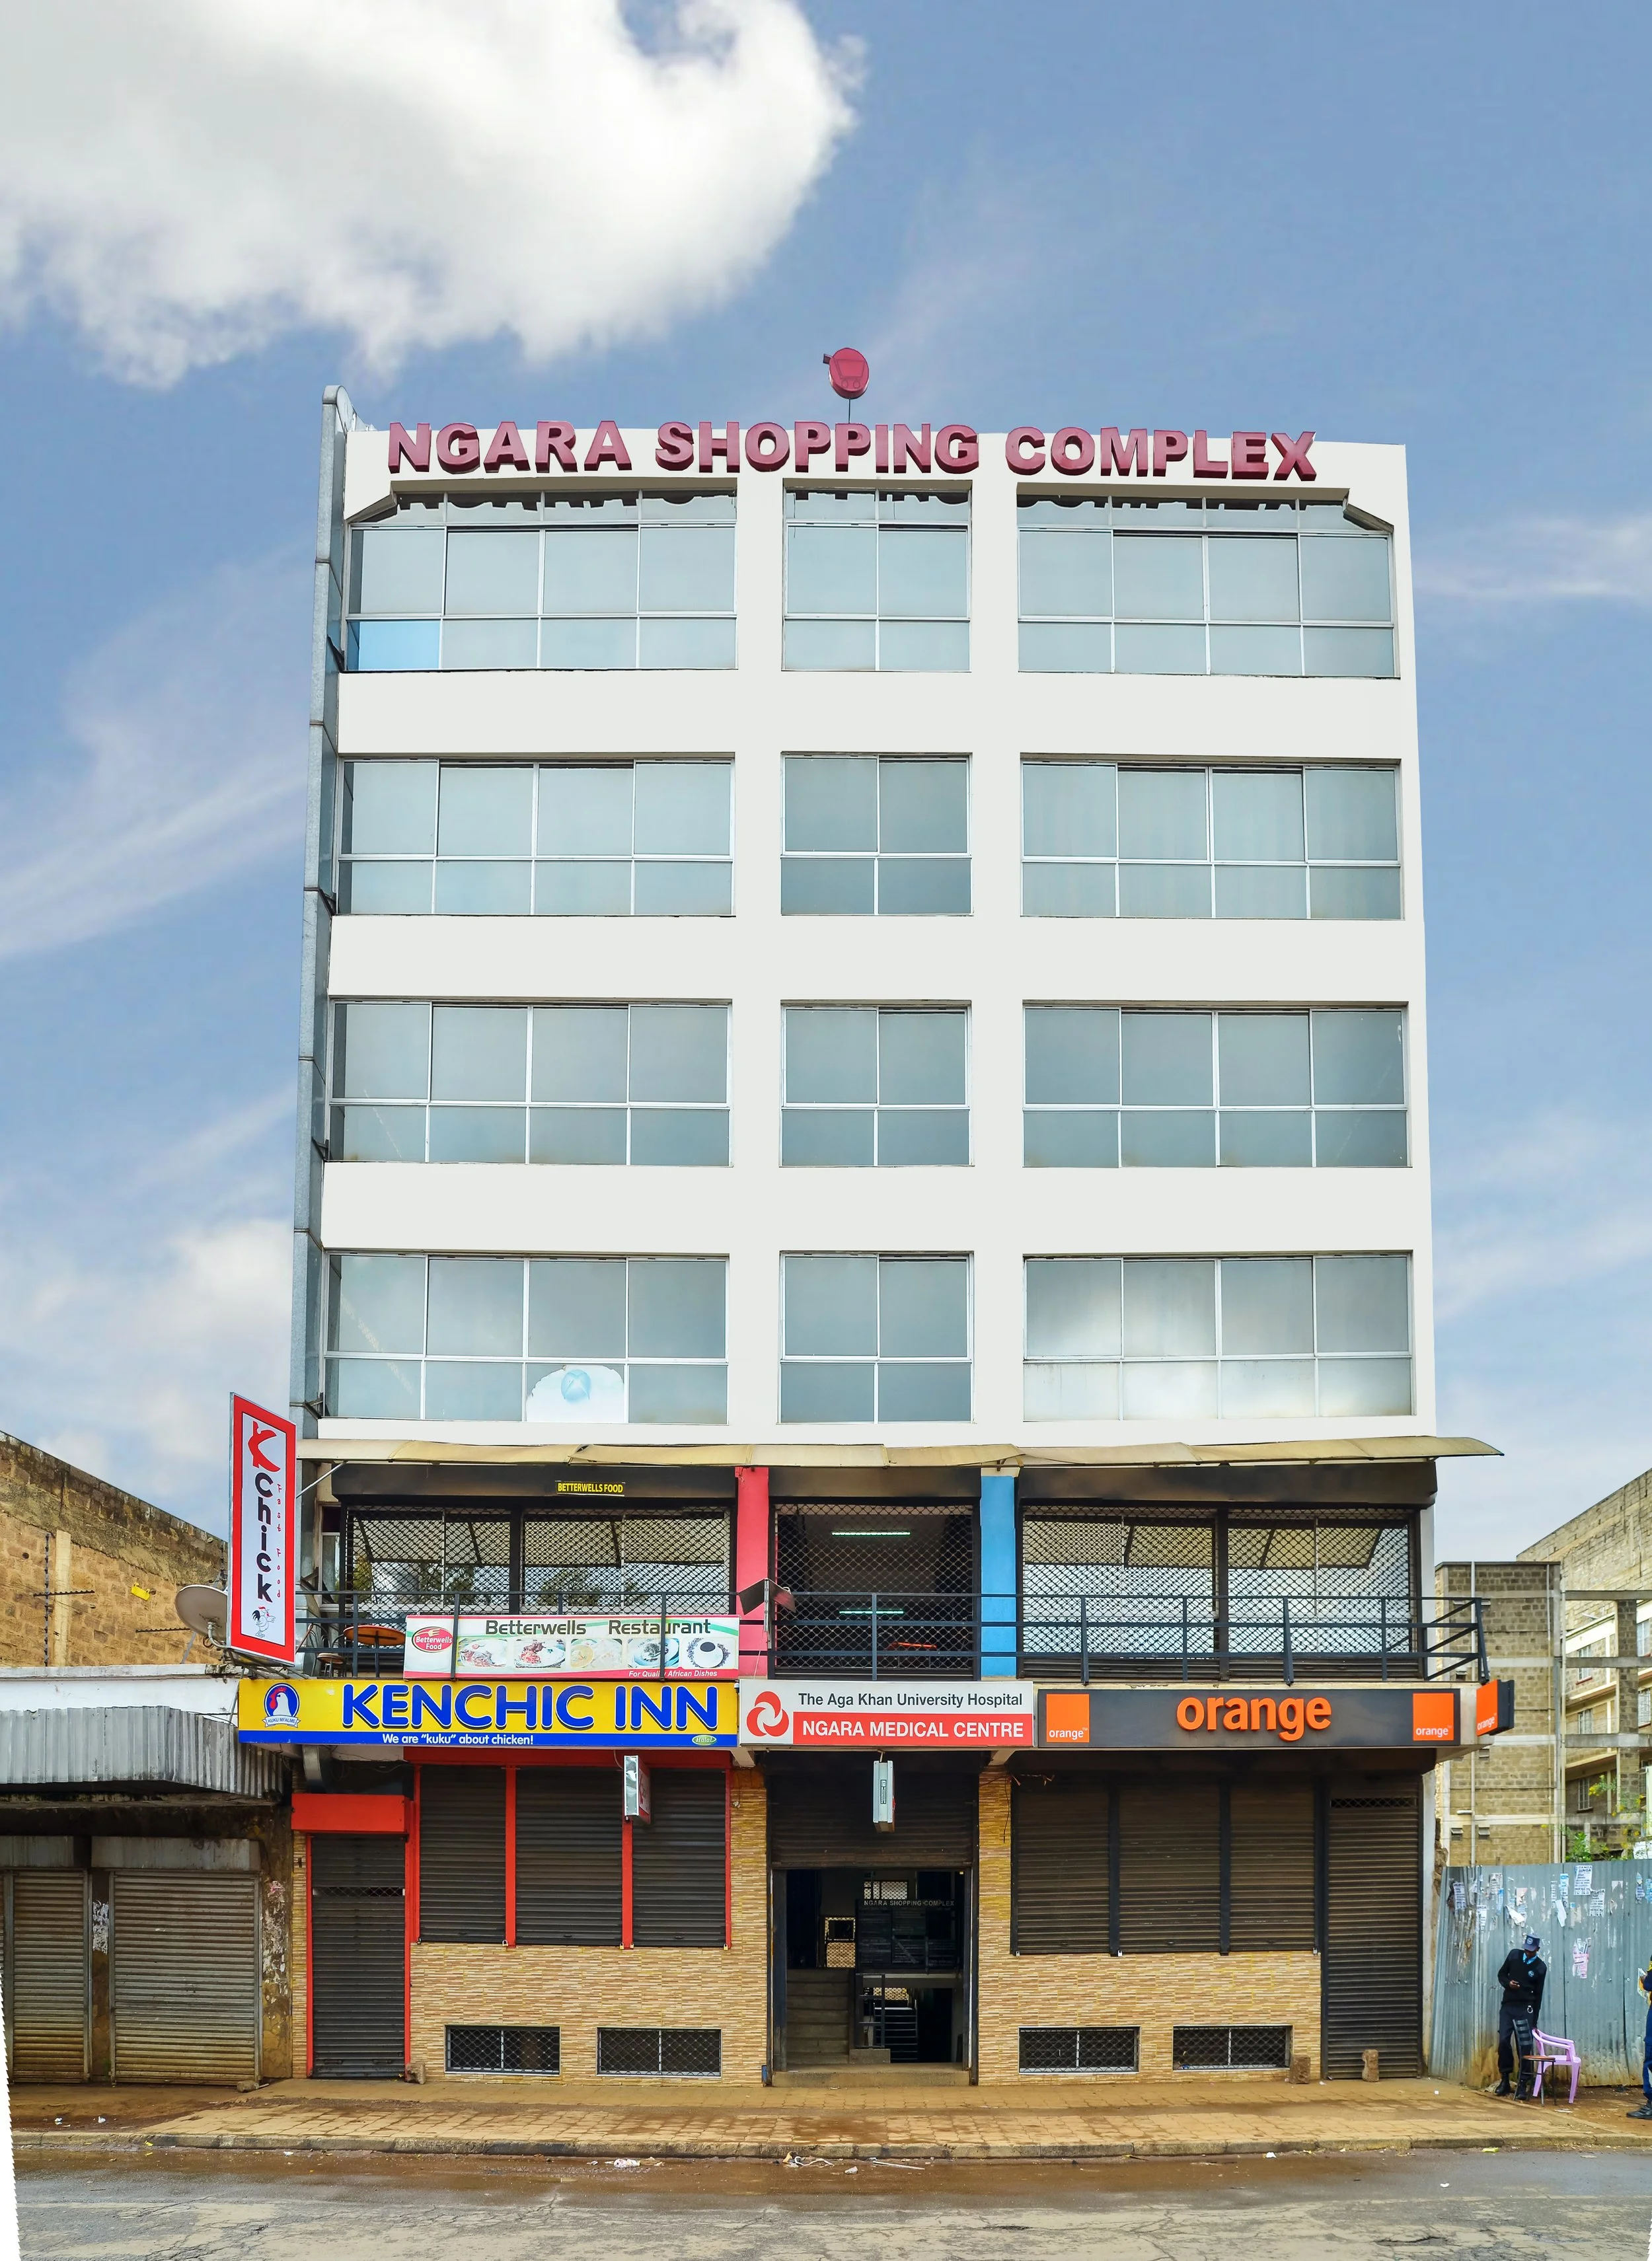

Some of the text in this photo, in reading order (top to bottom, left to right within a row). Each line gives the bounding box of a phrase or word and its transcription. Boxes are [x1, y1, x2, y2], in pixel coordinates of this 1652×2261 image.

[388, 420, 1318, 482] NGARA SHOPPING COMPLEX
[558, 1483, 623, 1493] BETTERWELLS FOOD
[485, 1619, 587, 1635] Betterwells
[415, 1635, 453, 1644] Betterwells
[342, 1683, 718, 1730] KENCHIC INN
[798, 1693, 1023, 1709] The Aga Khan University Hospital
[1177, 1697, 1333, 1742] orange
[803, 1720, 1024, 1738] NGARA MEDICAL CENTRE
[382, 1733, 399, 1744] We
[401, 1735, 419, 1744] are
[459, 1734, 490, 1744] about
[491, 1734, 534, 1745] chicken!
